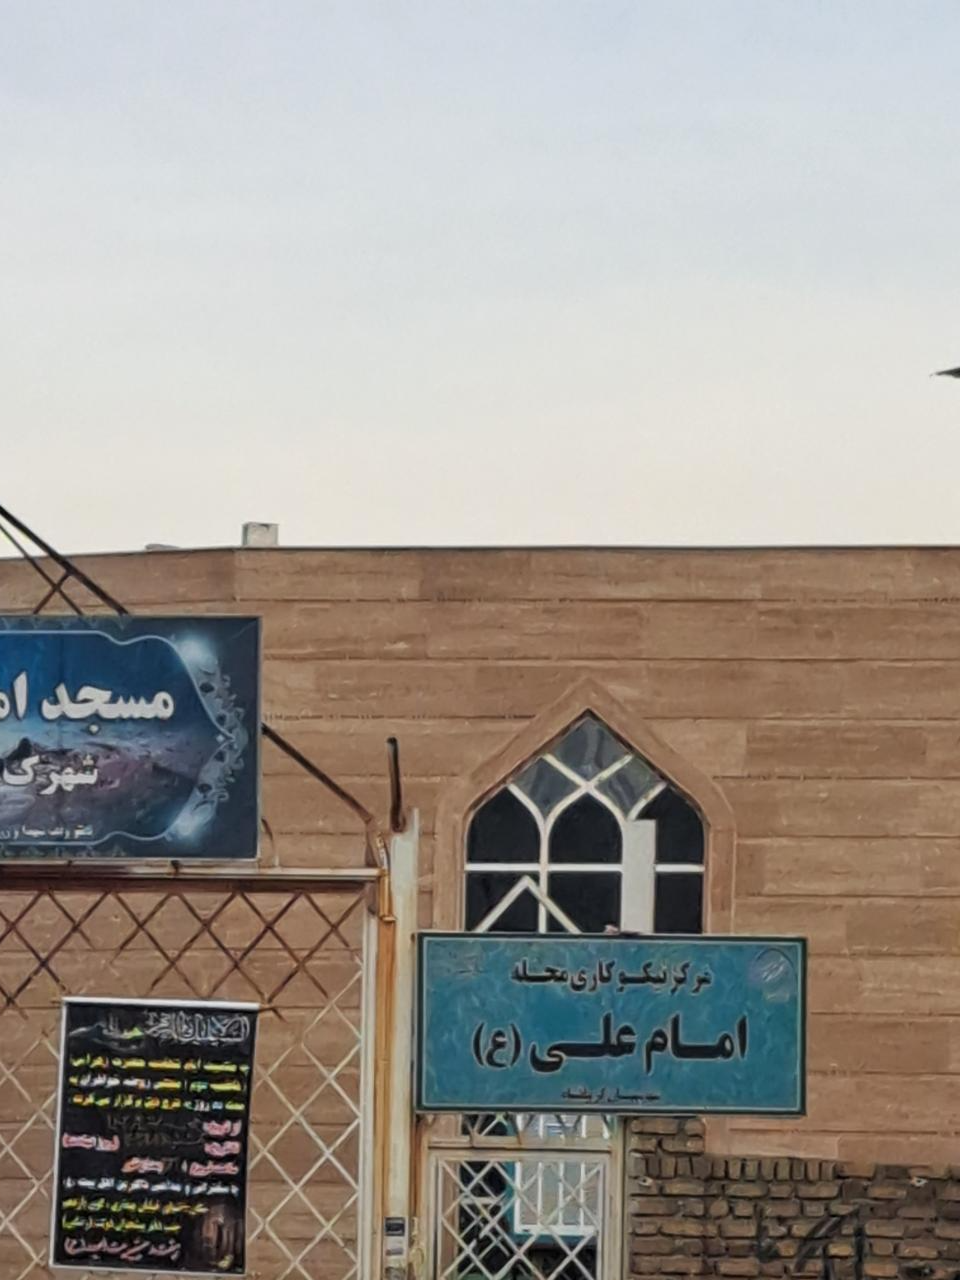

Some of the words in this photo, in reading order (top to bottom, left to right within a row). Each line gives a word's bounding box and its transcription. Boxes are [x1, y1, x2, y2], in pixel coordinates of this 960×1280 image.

[41, 674, 175, 735] مسجد
[3, 754, 99, 796] شهرک
[510, 957, 568, 985] محله
[671, 960, 712, 995] مرکز
[471, 1022, 522, 1069] (ع)
[529, 1011, 637, 1074] علی
[643, 1012, 748, 1075] امام
